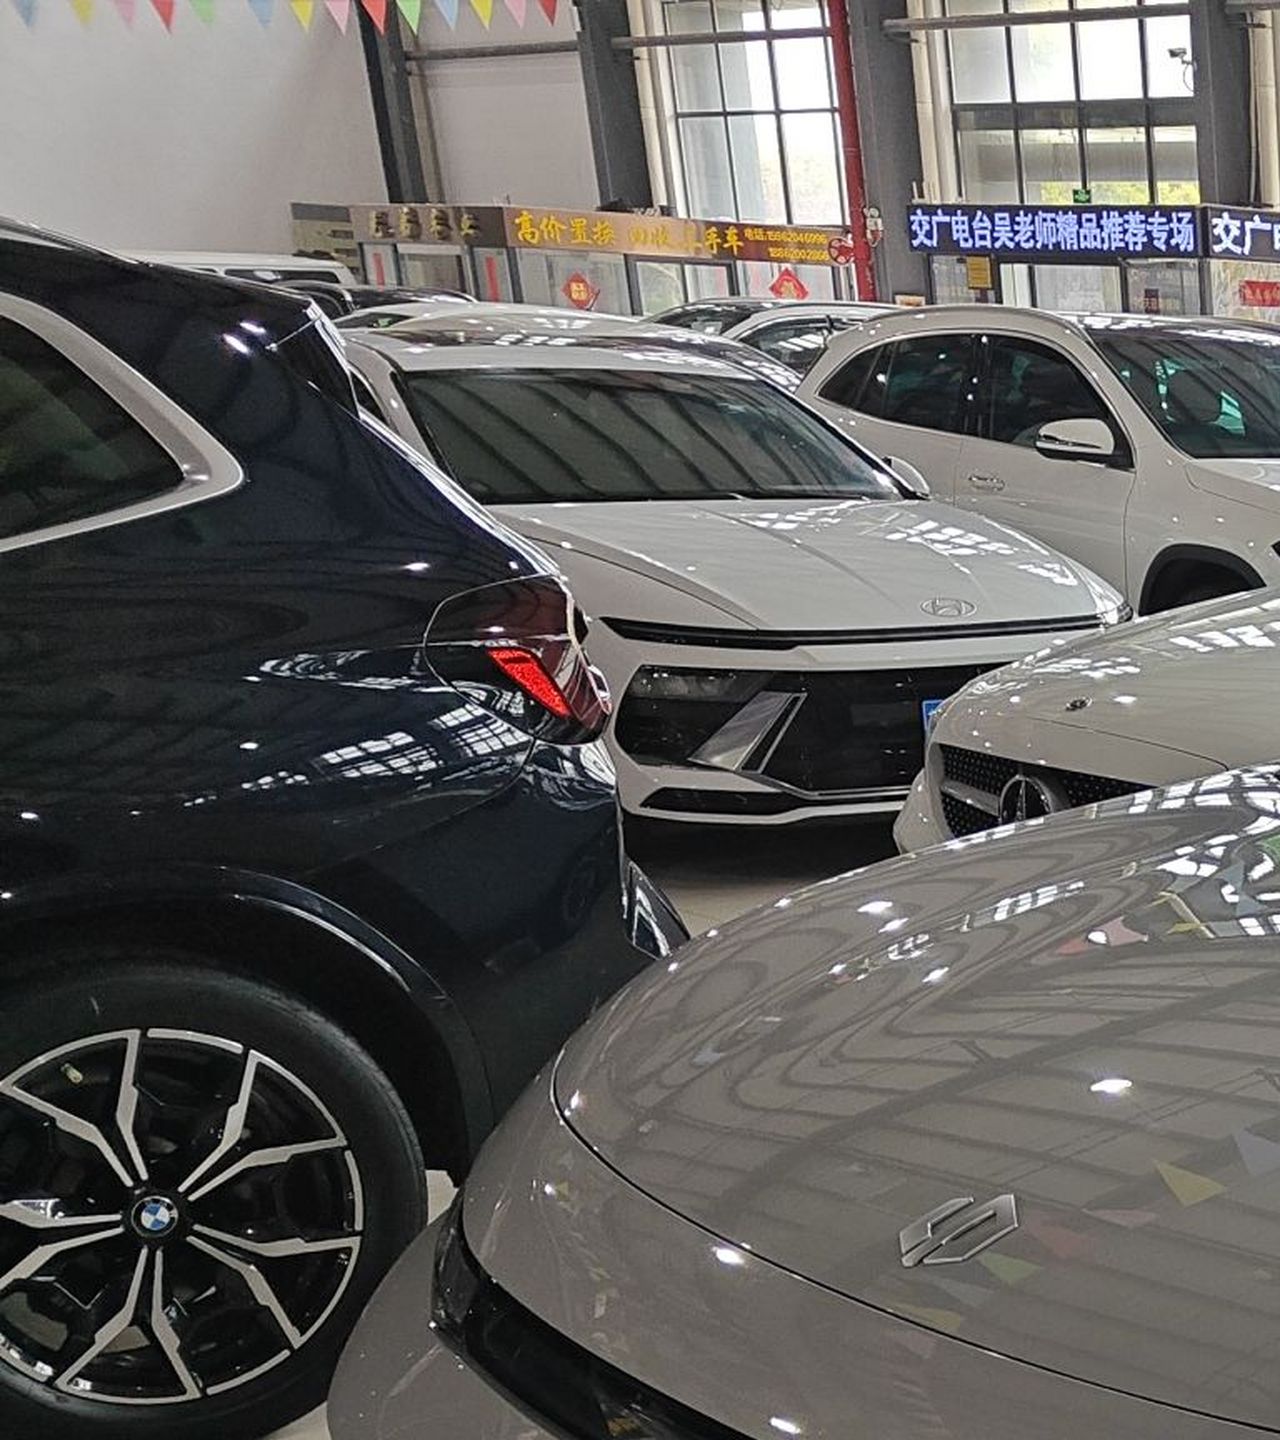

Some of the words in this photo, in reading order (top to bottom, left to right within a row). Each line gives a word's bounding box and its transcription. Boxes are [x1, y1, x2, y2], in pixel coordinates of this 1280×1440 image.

[910, 208, 1194, 252] 交广电台吴老师精品推荐专场
